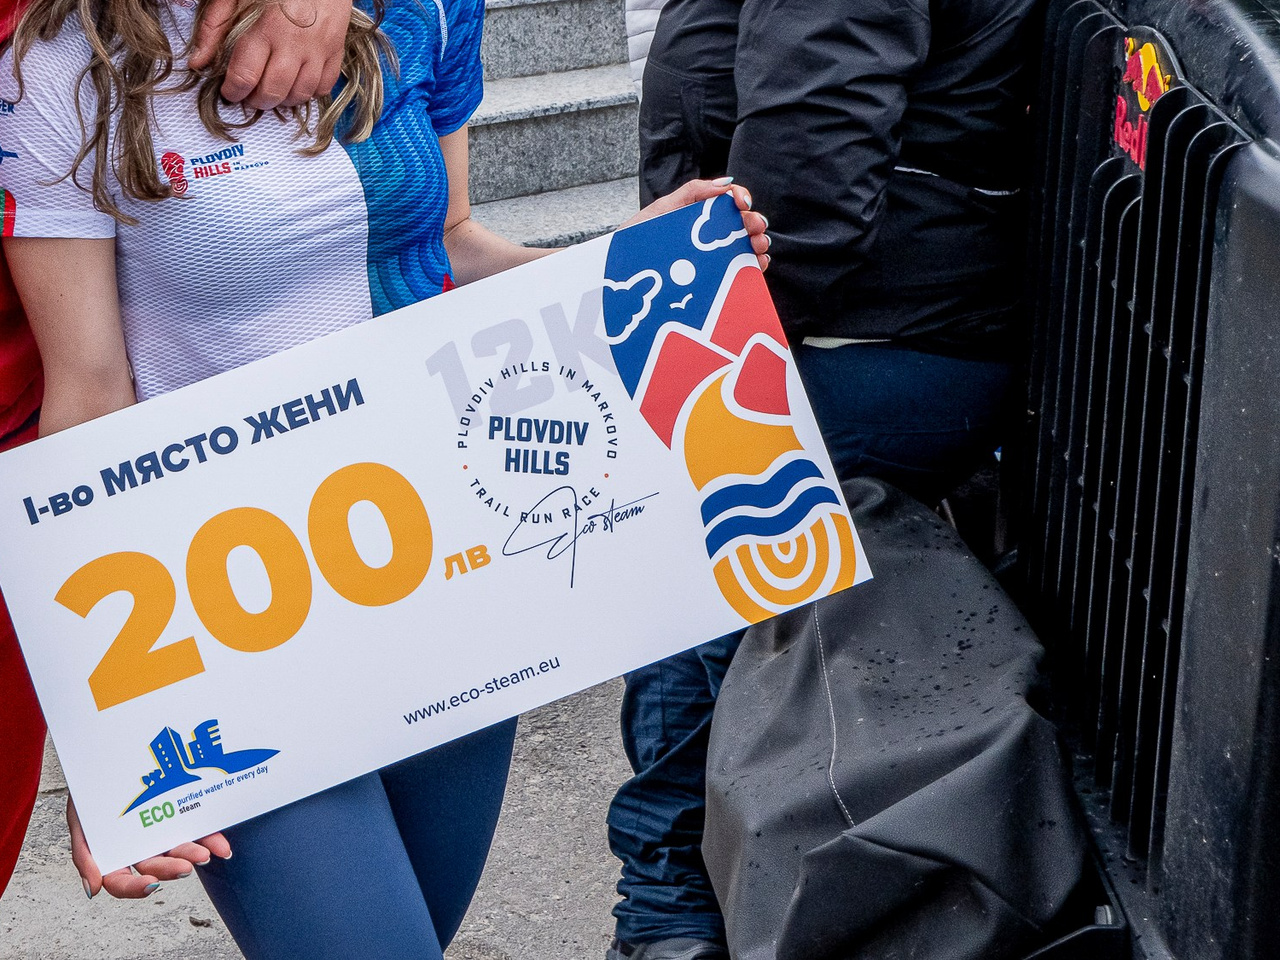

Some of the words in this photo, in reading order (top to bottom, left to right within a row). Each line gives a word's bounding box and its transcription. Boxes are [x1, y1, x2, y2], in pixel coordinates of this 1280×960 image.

[190, 143, 244, 166] PLOVDIV
[193, 161, 232, 179] HILLS
[457, 377, 495, 450] PLOVDIV
[500, 360, 551, 381] HILLS
[559, 365, 577, 381] IN
[581, 378, 618, 460] MARKOVO
[488, 415, 590, 446] PLOVDIV
[99, 425, 239, 498] МЯСТО
[242, 377, 366, 445] ЖЕНИ
[504, 447, 570, 476] HILLS
[469, 477, 511, 518] TRAIL
[520, 510, 554, 525] RUN
[561, 486, 601, 519] RACE
[53, 461, 434, 713] 200
[402, 655, 561, 727] www.eco-steam.eu
[177, 789, 203, 806] purified
[205, 782, 223, 795] water
[225, 779, 234, 787] for
[237, 772, 255, 783] every
[257, 765, 268, 776] day
[139, 801, 175, 828] ECO
[179, 801, 201, 814] steam
